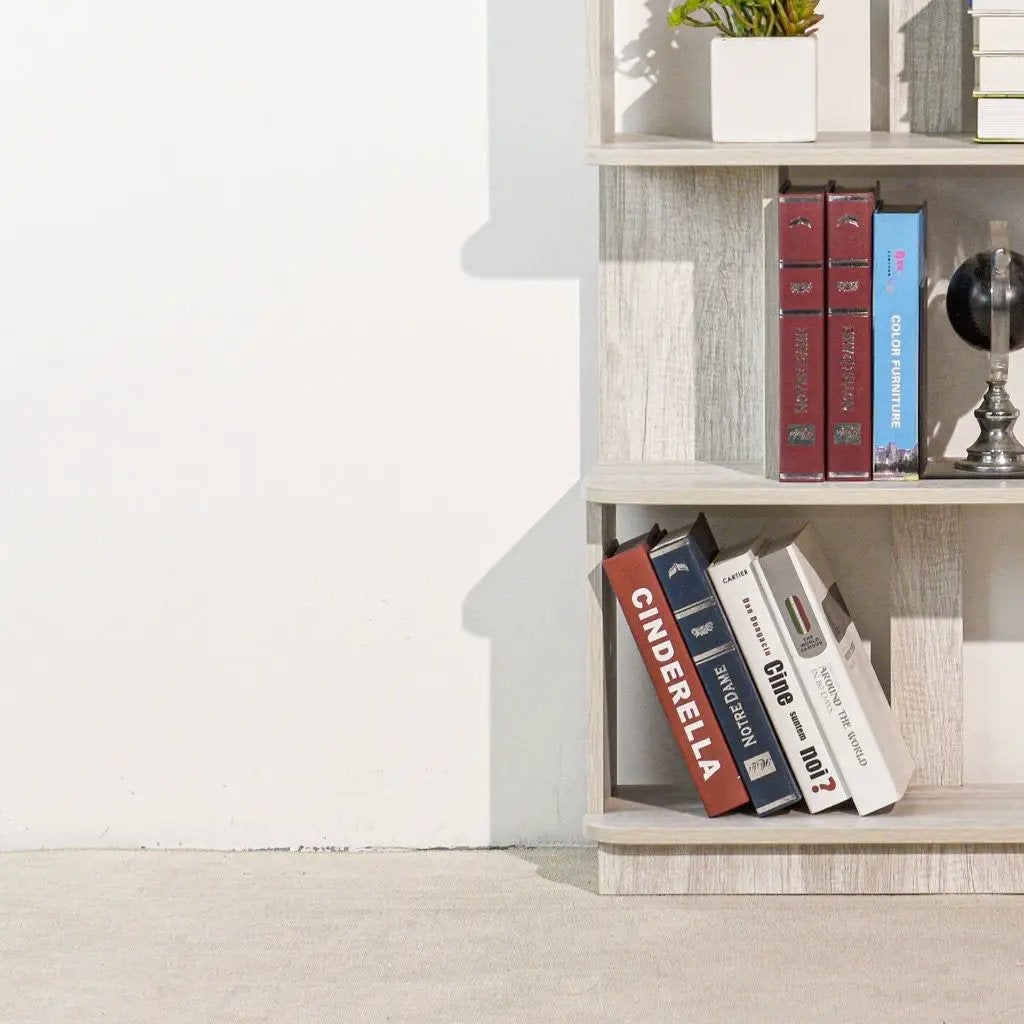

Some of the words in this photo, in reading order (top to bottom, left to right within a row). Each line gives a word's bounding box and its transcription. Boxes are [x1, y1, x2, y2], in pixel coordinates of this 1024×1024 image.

[891, 314, 901, 356] COLOR
[891, 359, 902, 429] FURNITURE
[722, 569, 748, 584] CARTIER
[742, 597, 754, 614] Dan
[631, 587, 721, 782] CINDERELLA
[713, 664, 739, 705] DAME
[729, 705, 758, 748] NOTRE
[763, 659, 794, 706] Cine
[789, 710, 807, 742] suntem
[799, 745, 837, 793] noi?
[819, 665, 842, 707] AROUND
[837, 708, 852, 730] THE
[847, 731, 868, 767] WORLD
